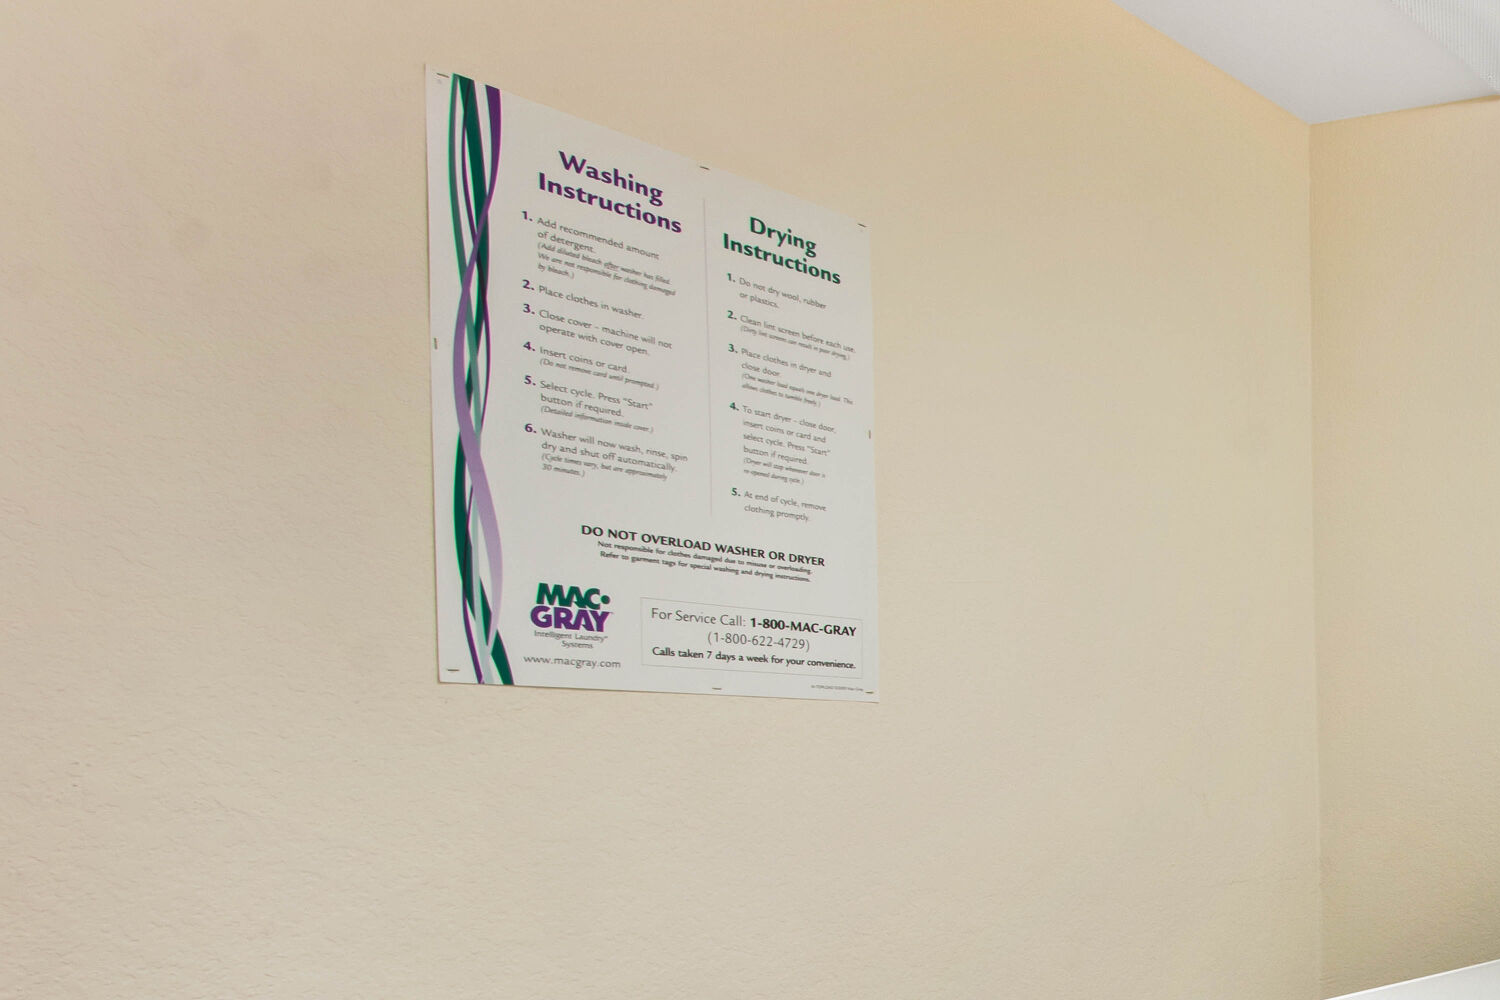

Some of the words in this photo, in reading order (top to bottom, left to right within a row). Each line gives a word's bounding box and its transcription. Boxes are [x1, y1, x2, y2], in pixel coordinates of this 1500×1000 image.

[559, 150, 663, 207] Washing
[538, 172, 682, 233] Instructions
[559, 225, 624, 249] recommended
[626, 245, 659, 260] amount
[750, 216, 817, 258] Drying
[723, 233, 841, 284] Instructions
[522, 279, 535, 291] 2.
[538, 285, 563, 299] Place
[565, 293, 598, 308] clothes
[523, 304, 535, 315] 3.
[538, 309, 565, 323] Close
[567, 318, 592, 328] cover
[601, 326, 639, 341] machine
[640, 336, 655, 344] will
[658, 340, 672, 349] not
[539, 380, 568, 393] Select
[570, 388, 595, 399] cycle.
[598, 392, 620, 404] Press
[622, 397, 653, 410] "Start"
[540, 427, 577, 441] Washer
[578, 436, 595, 444] will
[618, 444, 643, 455] wash,
[646, 448, 668, 459] rinse,
[670, 453, 688, 462] spin
[581, 525, 604, 536] DO
[607, 528, 637, 541] NOT
[640, 533, 711, 551] OVERLOAD
[714, 543, 765, 558] WASHER
[768, 550, 785, 561] OR
[788, 553, 825, 566] DRYER
[530, 606, 610, 633] GRAY
[651, 607, 672, 619] For
[675, 610, 716, 624] Service
[720, 614, 745, 626] Call:
[750, 617, 856, 636] 1-800-MAC-GRAY
[534, 630, 572, 640] Intelligent
[561, 640, 594, 649] Systems
[708, 632, 810, 652] (1-800-622-4729)
[523, 656, 621, 669] www.macgray.com
[652, 646, 675, 656] Calls
[678, 648, 704, 658] taken
[706, 650, 712, 659] 7
[715, 651, 736, 663] days
[746, 654, 768, 663] week
[770, 654, 784, 663] for
[785, 658, 805, 667] your
